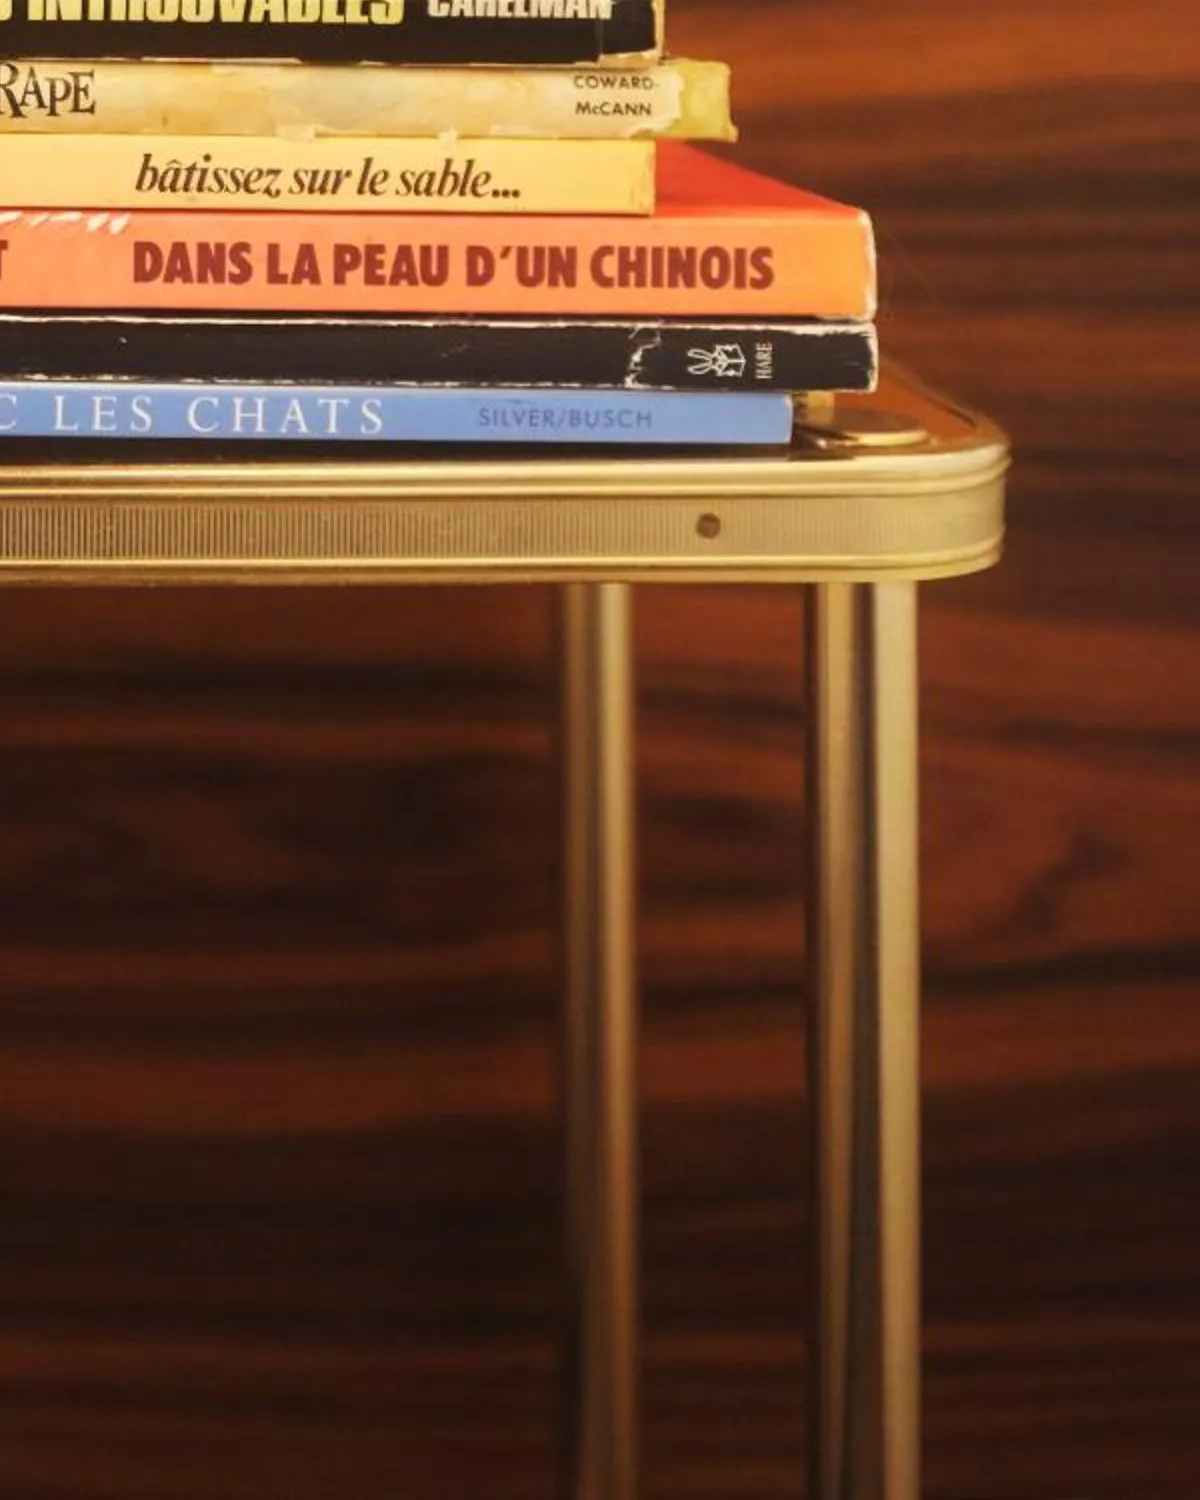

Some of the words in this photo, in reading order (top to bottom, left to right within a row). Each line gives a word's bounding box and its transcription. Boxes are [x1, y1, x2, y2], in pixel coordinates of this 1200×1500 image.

[575, 101, 652, 116] McCANN
[135, 154, 282, 199] bâtissez
[288, 170, 352, 196] sur
[356, 157, 389, 197] le
[394, 159, 521, 200] sable...
[133, 241, 253, 285] DANS
[266, 243, 321, 285] LA
[333, 245, 450, 287] PEAU
[465, 246, 578, 288] D'UN
[589, 246, 775, 290] CHINOIS
[756, 341, 773, 379] HARE
[54, 395, 153, 432] LES
[187, 398, 384, 434] CHATS
[479, 407, 653, 429] SILVER/BUSCH
